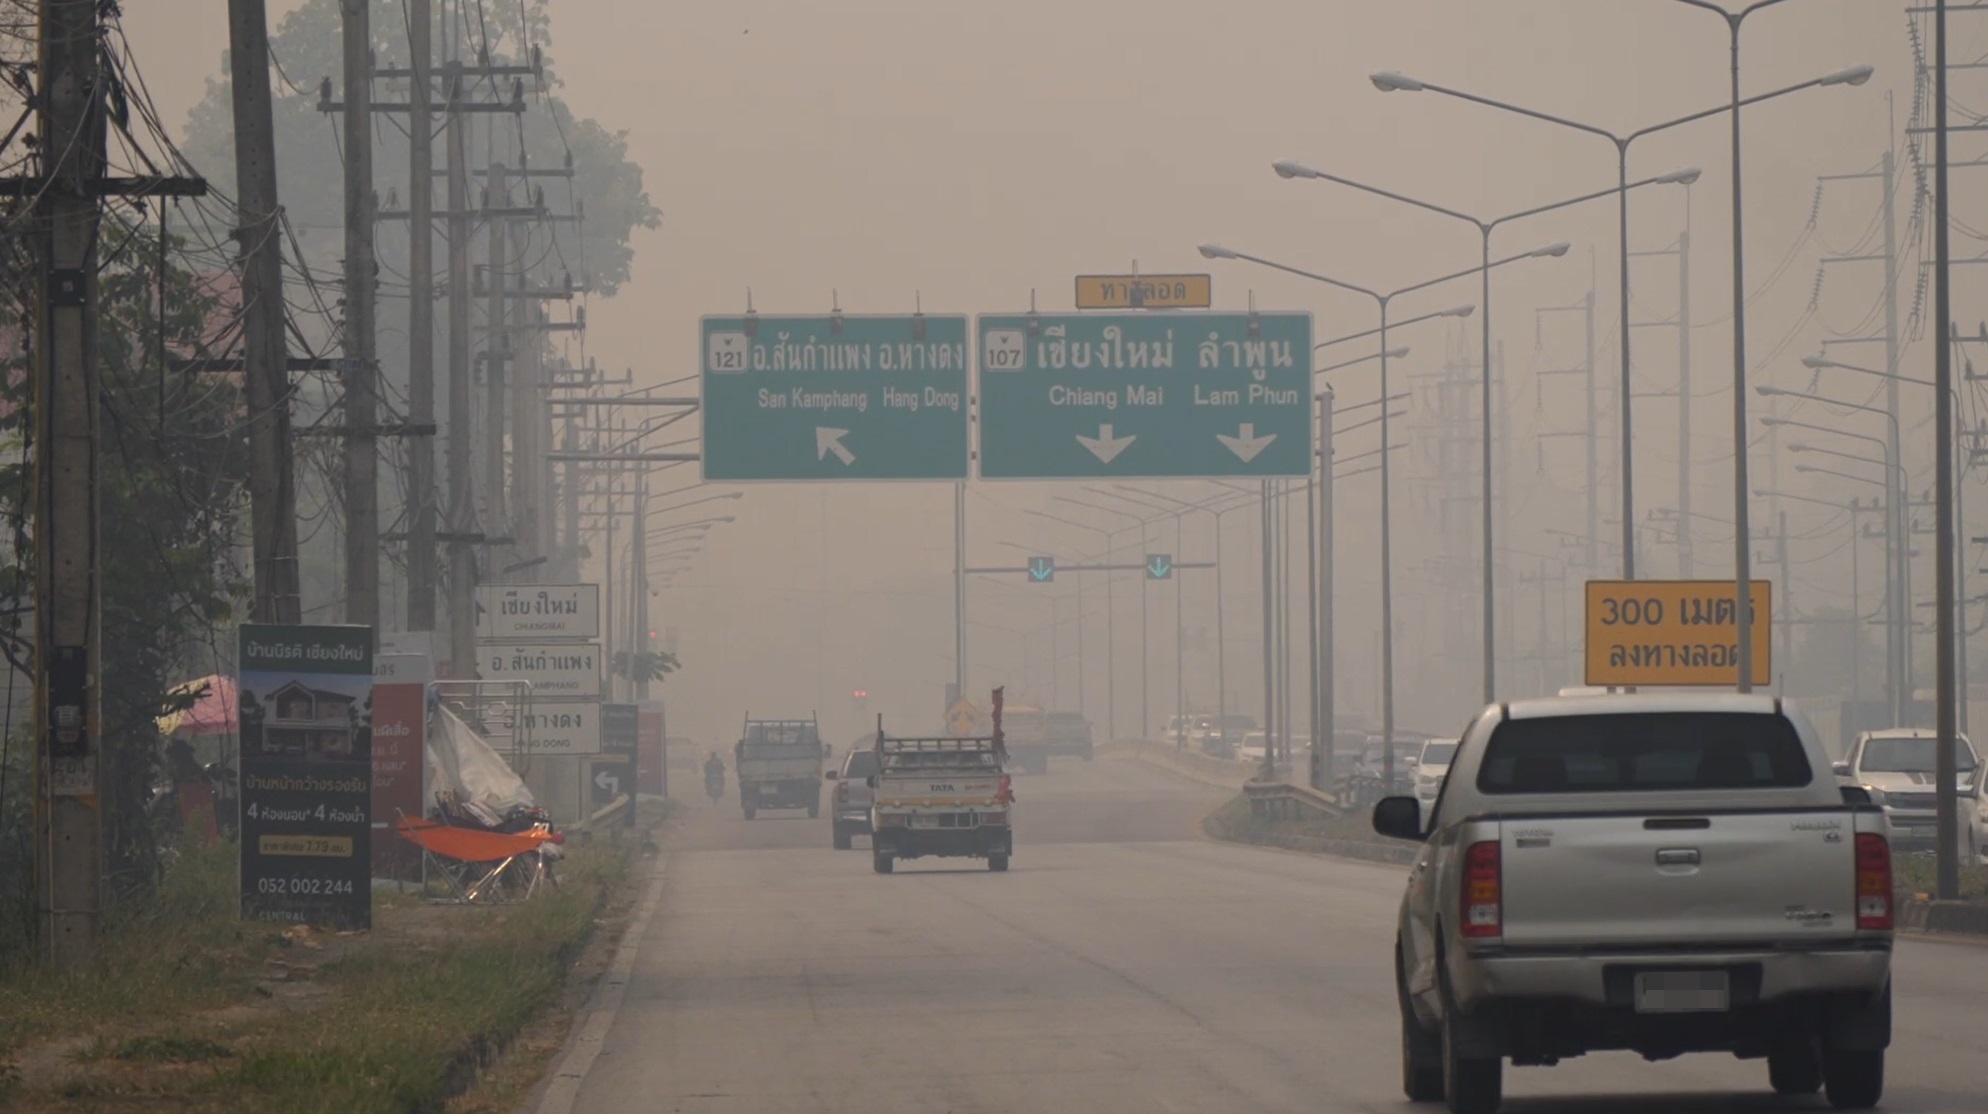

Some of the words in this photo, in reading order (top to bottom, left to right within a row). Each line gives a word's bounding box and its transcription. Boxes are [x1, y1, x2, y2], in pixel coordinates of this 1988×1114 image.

[1100, 281, 1186, 301] ทาลอด
[715, 351, 743, 368] 121
[752, 331, 872, 371] อ.สันกำแพง
[879, 342, 963, 370] อ.หางดง
[988, 349, 1021, 367] 107
[1037, 324, 1174, 369] เชียงใหม่
[1198, 331, 1294, 381] ลำพูน
[758, 388, 786, 408] San
[792, 387, 868, 412] Kamphang
[883, 387, 918, 412] Hang
[924, 386, 959, 412] Dong
[1049, 385, 1118, 410] Chiang
[1127, 386, 1164, 405] Mai
[1194, 385, 1239, 405] Lam
[1248, 384, 1298, 405] Phun
[501, 590, 578, 615] เชียงใหม่
[1600, 598, 1663, 626] 300
[306, 643, 364, 661] เชียงใหม่
[929, 784, 955, 792] TATA
[246, 802, 258, 820] 4
[314, 803, 326, 821] 4
[329, 805, 365, 822] ห้องน้ำ
[258, 878, 286, 893] 052
[290, 878, 320, 894] 002
[324, 879, 353, 895] 244
